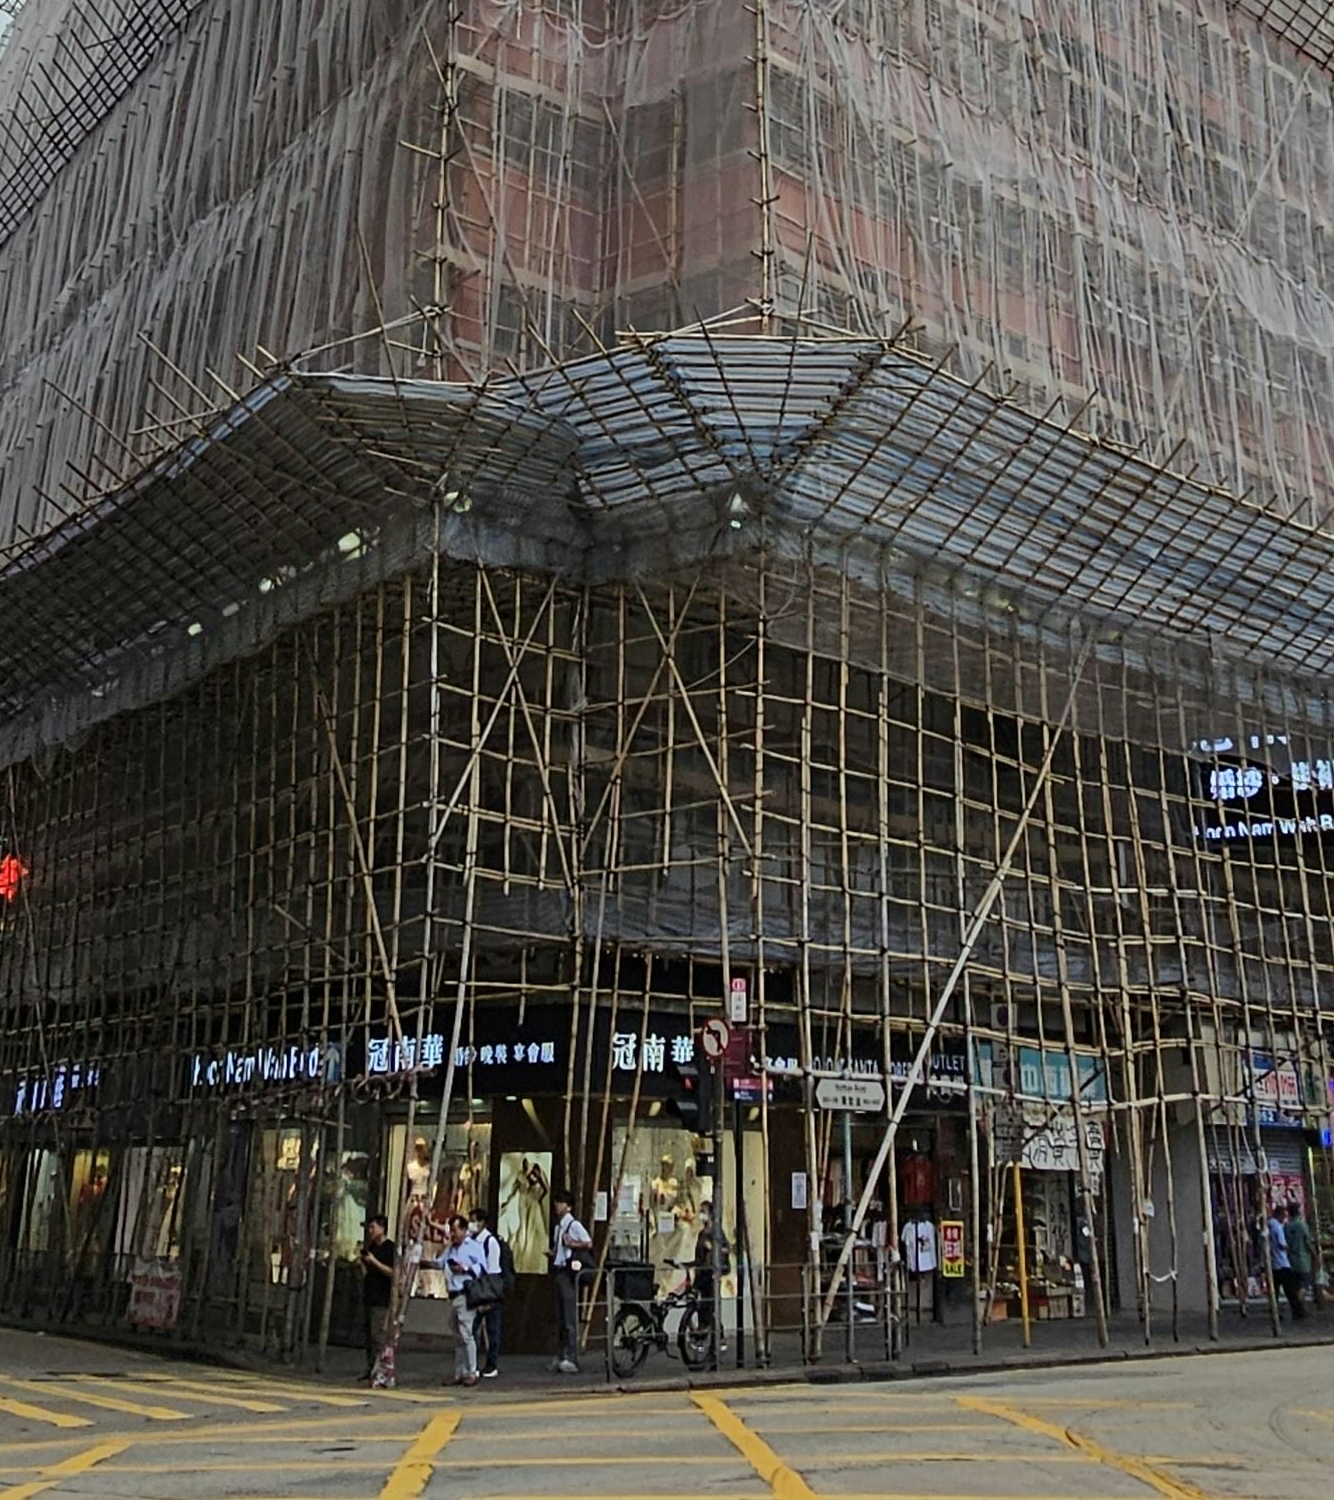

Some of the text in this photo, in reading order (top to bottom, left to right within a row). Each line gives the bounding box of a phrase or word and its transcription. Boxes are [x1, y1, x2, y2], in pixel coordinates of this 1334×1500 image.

[367, 1033, 445, 1072] 冠南華
[613, 1032, 696, 1073] 冠南華
